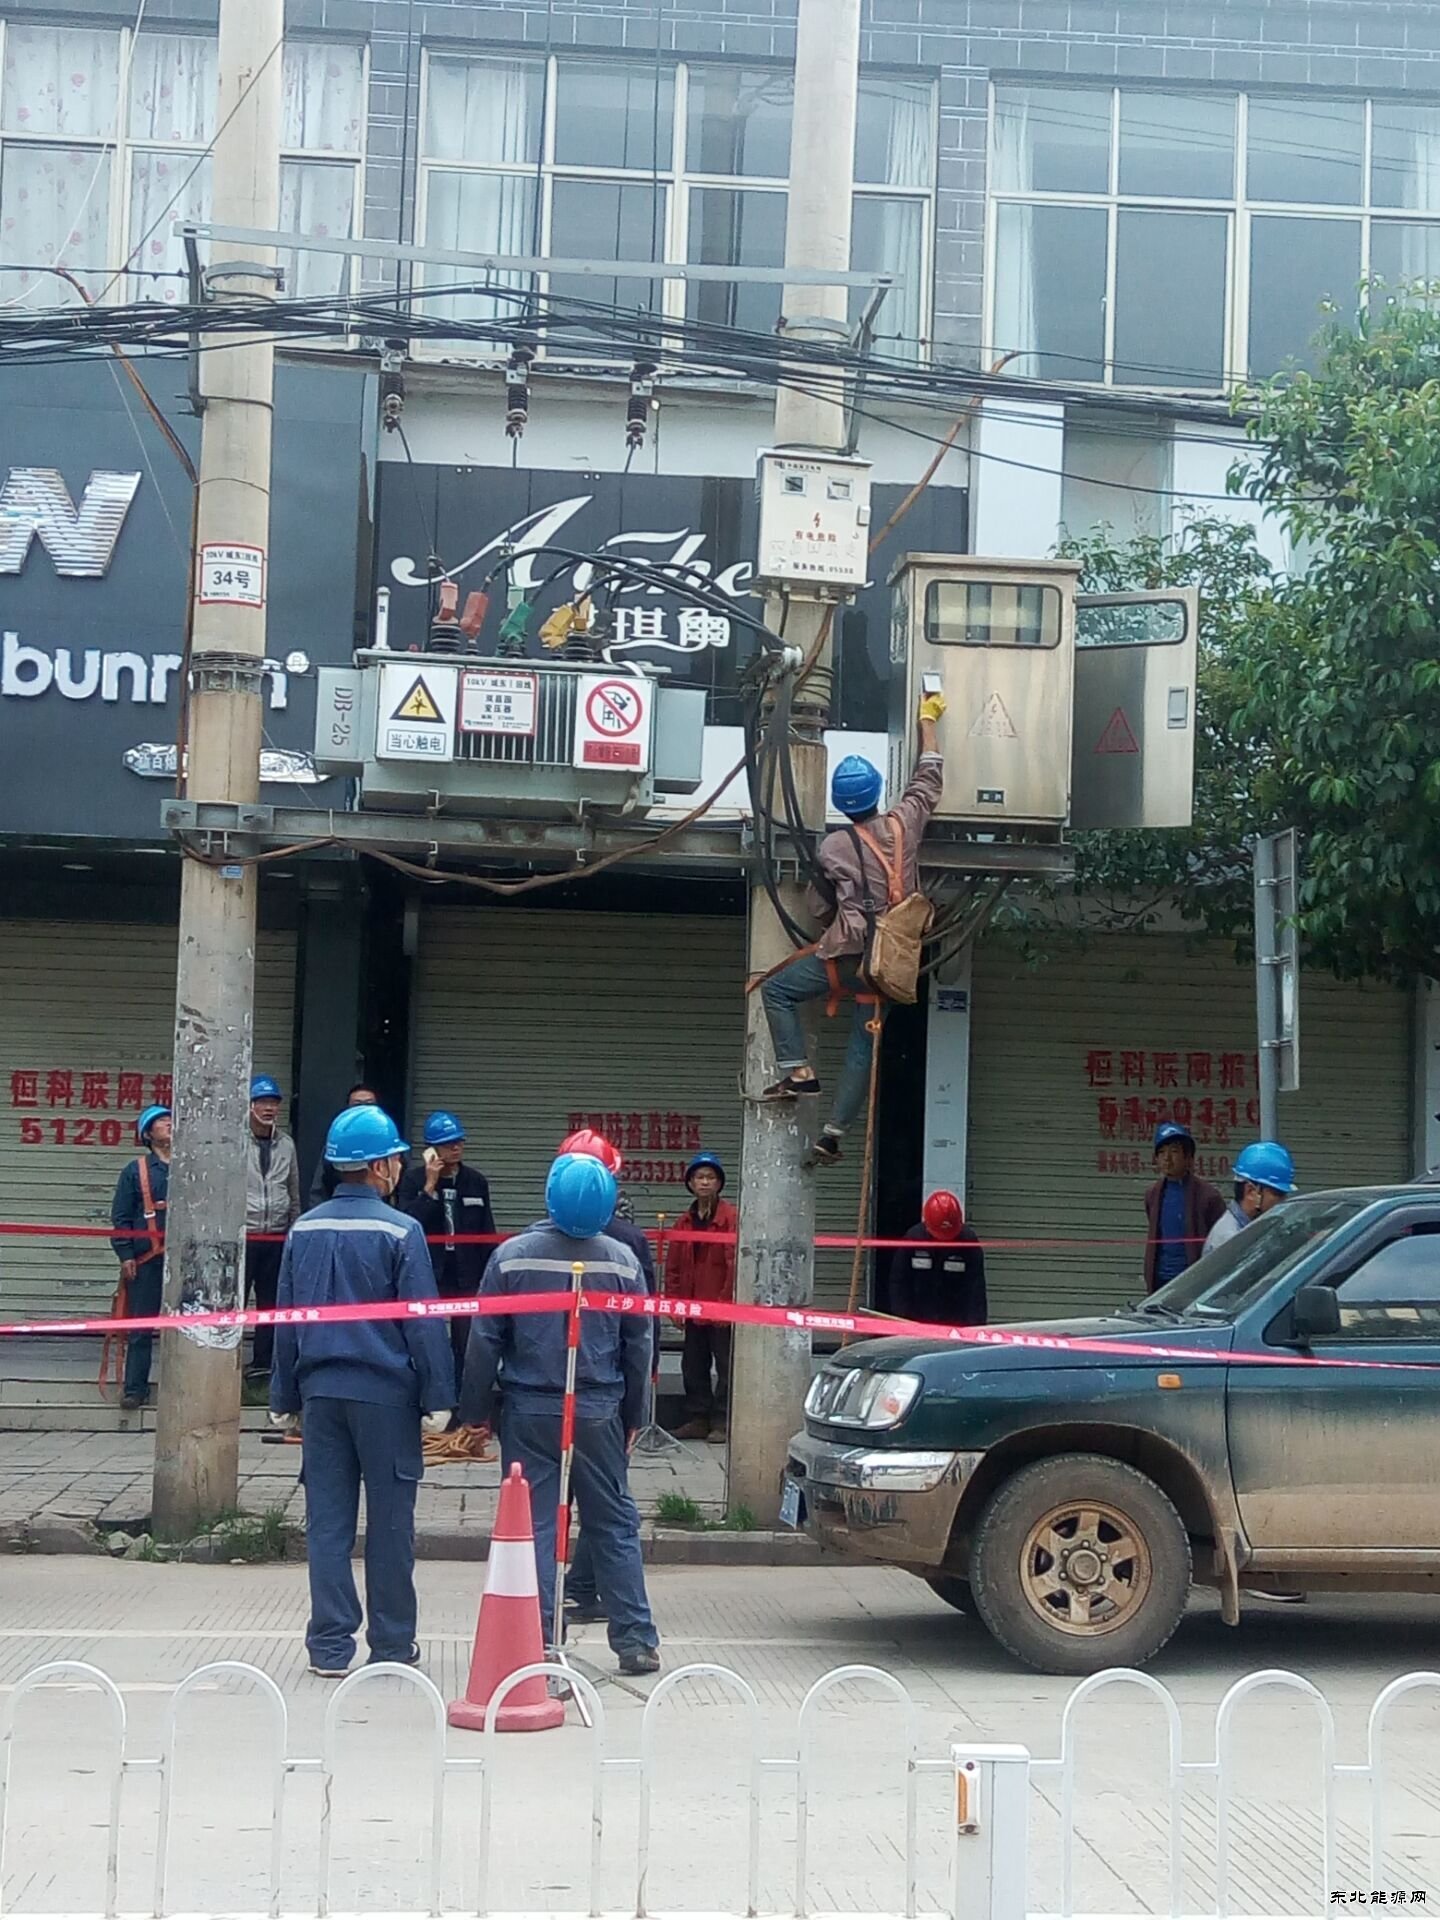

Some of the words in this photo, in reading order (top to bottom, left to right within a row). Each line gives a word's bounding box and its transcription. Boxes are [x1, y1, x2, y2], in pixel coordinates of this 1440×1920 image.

[212, 570, 251, 589] 34号
[331, 686, 354, 747] DB-25
[484, 704, 512, 714] 变压器
[390, 733, 442, 752] 当心触电
[606, 1296, 634, 1310] 止步
[643, 1300, 702, 1316] 高压危险
[256, 1310, 320, 1322] 高压危险
